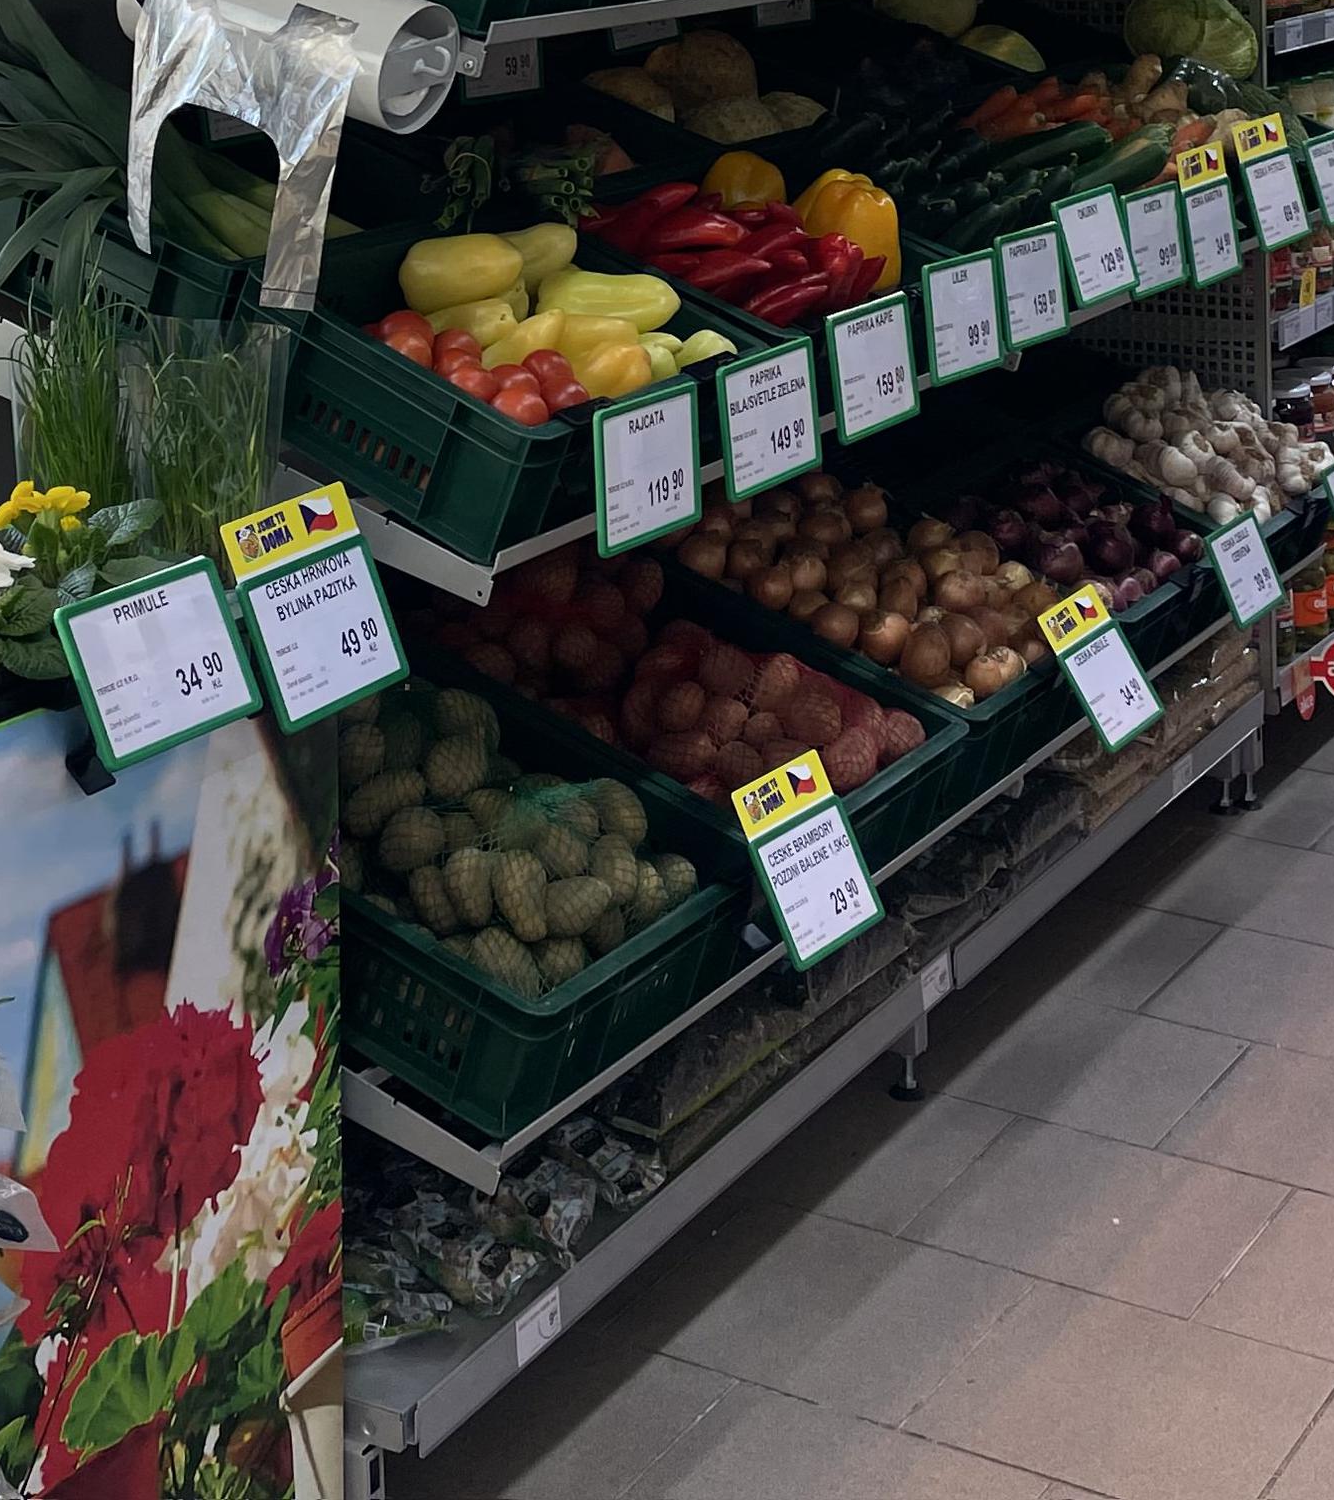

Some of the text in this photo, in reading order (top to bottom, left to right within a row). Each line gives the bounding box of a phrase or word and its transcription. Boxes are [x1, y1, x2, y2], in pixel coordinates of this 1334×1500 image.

[505, 56, 517, 76] 59
[847, 317, 875, 338] PAPRIKA
[968, 324, 979, 346] 99
[749, 365, 782, 388] PAPRIKA
[876, 366, 904, 397] 159 80
[730, 375, 806, 416] BILA/SVETLE ZELENA
[628, 409, 665, 435] RAJCATA
[770, 419, 805, 454] 149 90
[648, 469, 684, 506] 119 90
[261, 529, 293, 553] DOMA
[266, 551, 351, 601] CESKA HRNKOVA
[113, 591, 169, 624] PRIMULE
[276, 575, 358, 622] BYLINA PAZITKA
[341, 618, 378, 658] 49 80
[175, 652, 223, 696] 34 90
[1120, 686, 1135, 706] 34
[767, 820, 834, 867] CESKE BRAMBORY
[771, 847, 830, 890] POZDNI BALENE
[829, 878, 859, 914] 29 90
